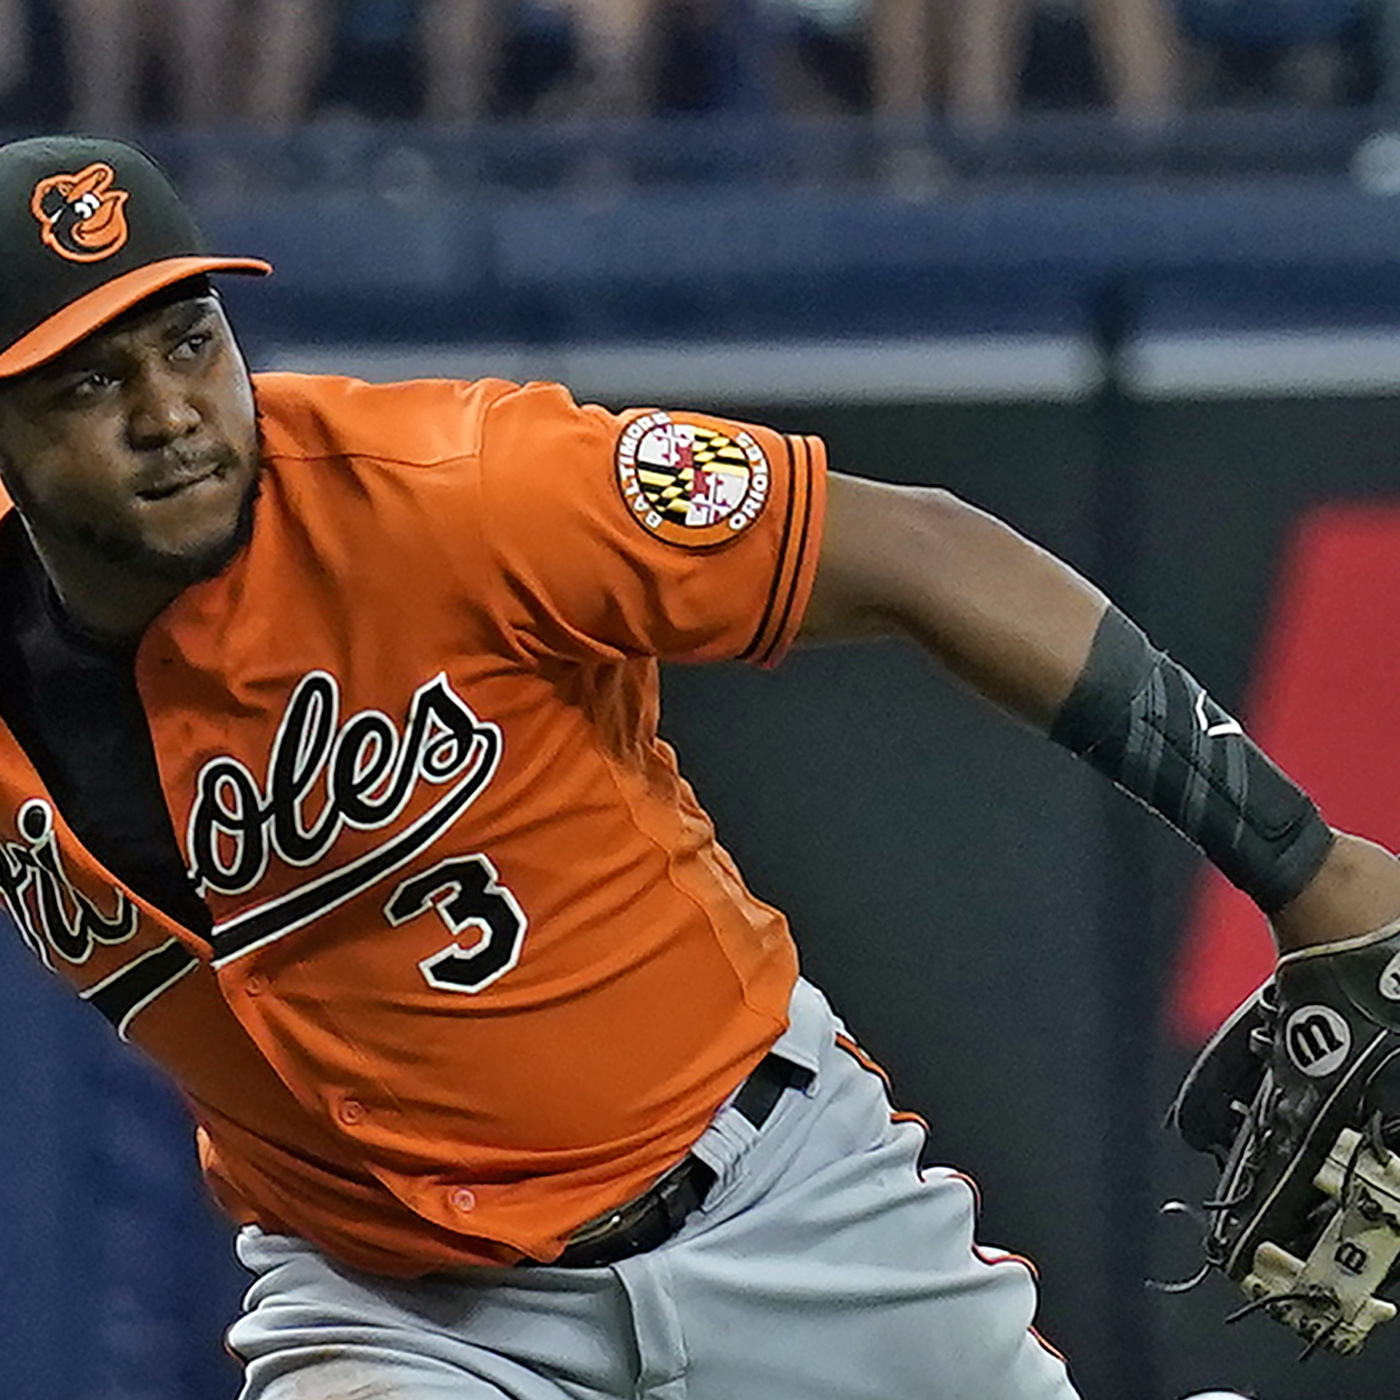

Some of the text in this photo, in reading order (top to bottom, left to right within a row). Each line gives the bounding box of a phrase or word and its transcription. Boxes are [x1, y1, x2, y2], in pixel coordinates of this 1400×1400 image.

[617, 411, 673, 529] BALTIMORE
[728, 431, 769, 531] ORIOLES
[384, 853, 528, 995] 3
